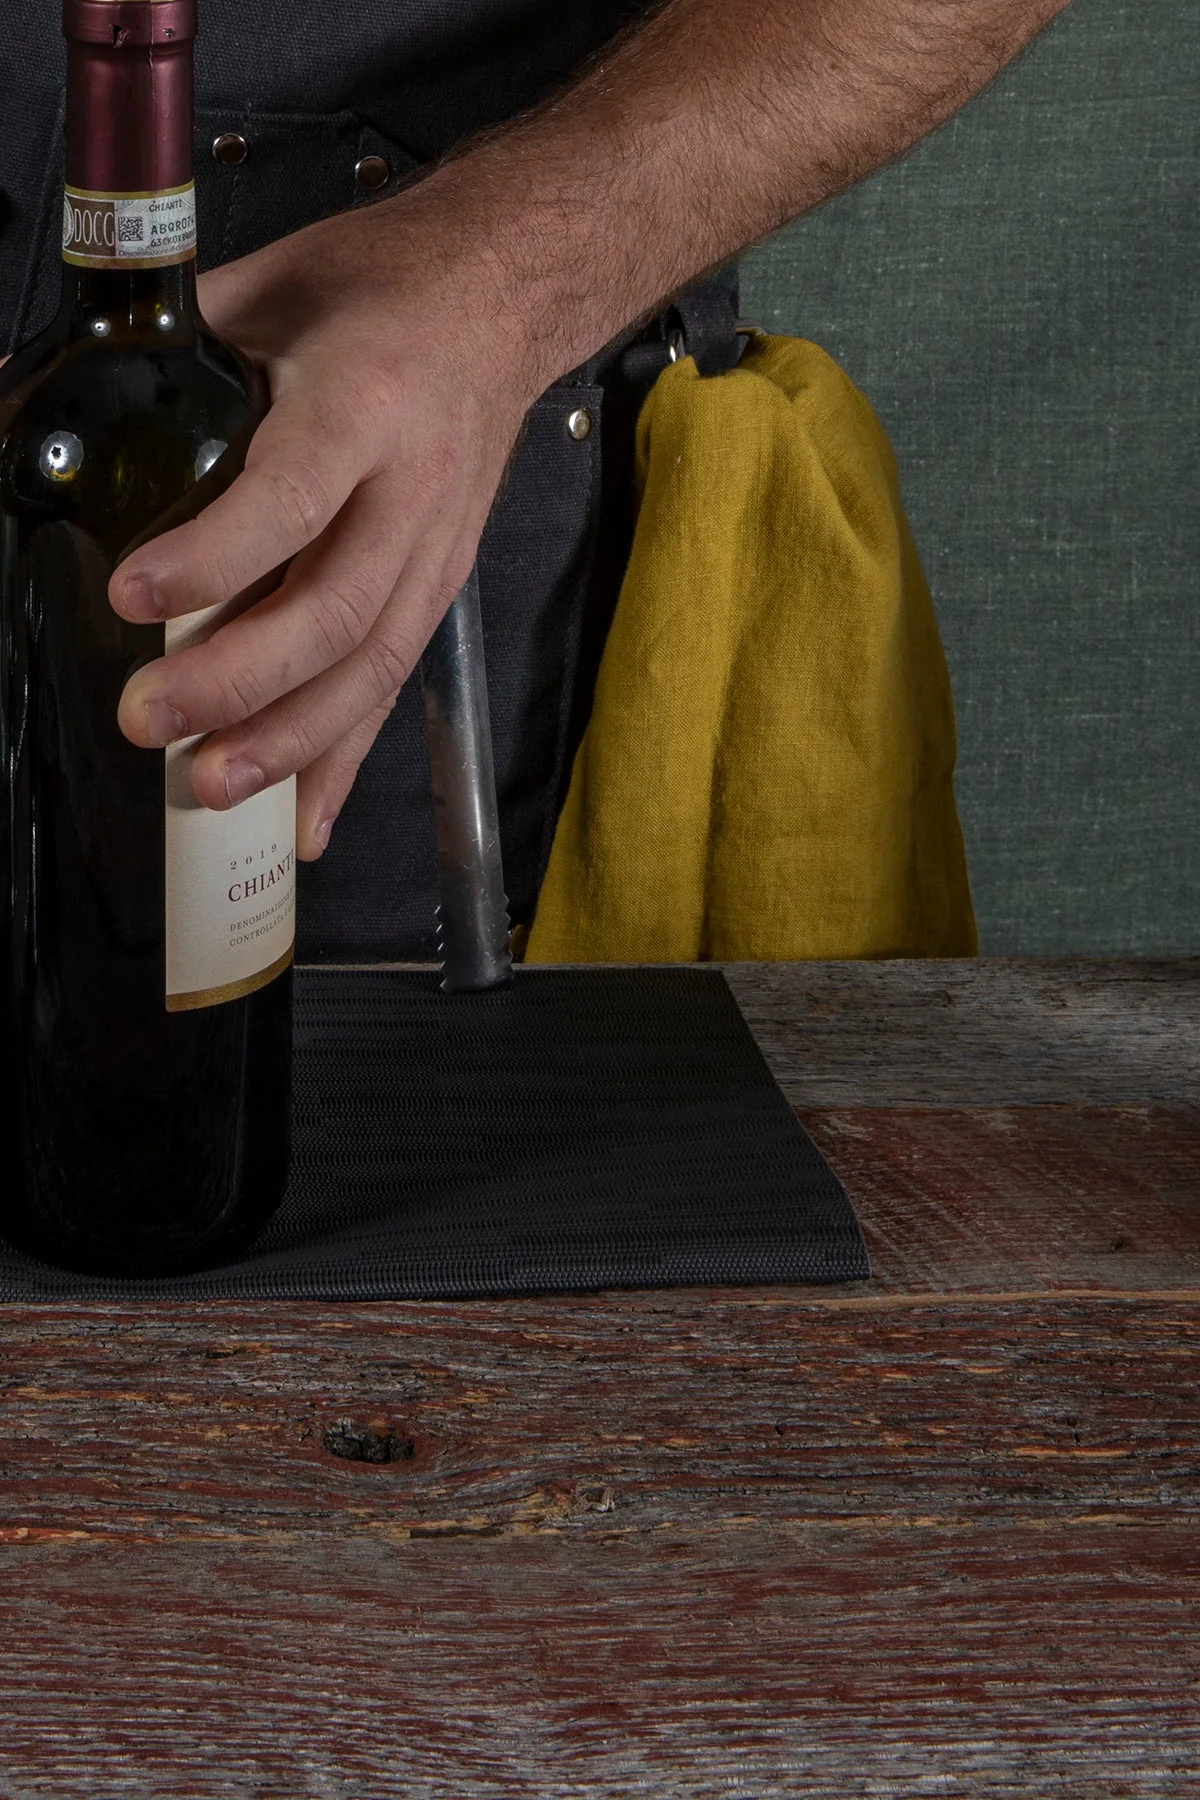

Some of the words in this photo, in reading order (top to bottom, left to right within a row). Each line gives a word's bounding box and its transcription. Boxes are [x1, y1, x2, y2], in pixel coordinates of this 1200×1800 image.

[149, 200, 182, 213] CHIANTI
[74, 208, 114, 247] DOCG
[229, 843, 277, 870] 2019
[228, 847, 294, 902] CHIANTI
